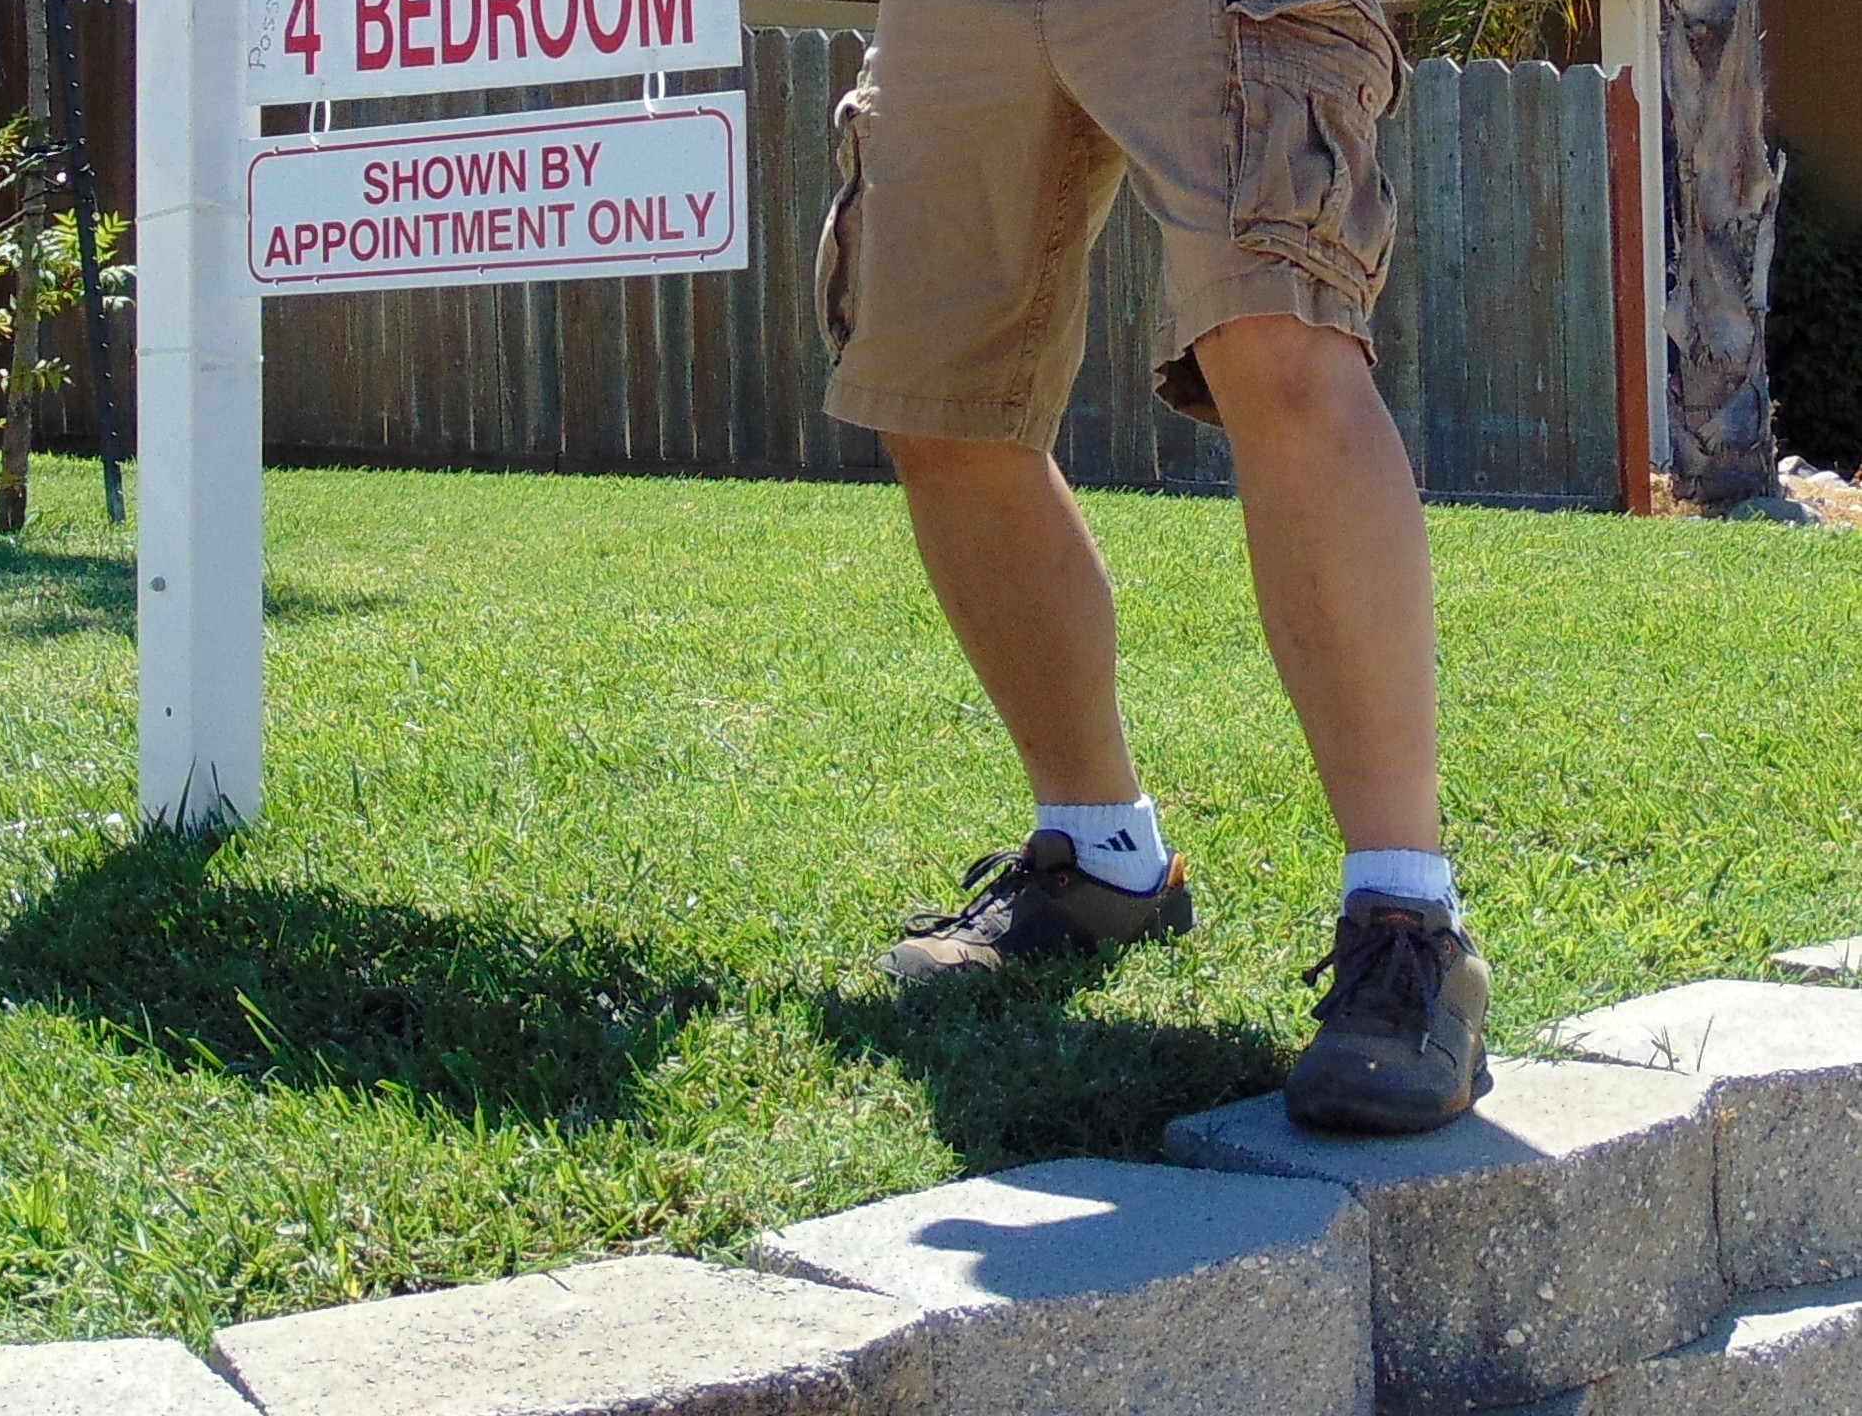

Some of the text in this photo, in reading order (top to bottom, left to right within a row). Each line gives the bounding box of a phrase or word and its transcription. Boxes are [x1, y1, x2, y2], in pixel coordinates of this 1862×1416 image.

[363, 141, 602, 205] SHOWN BY
[264, 191, 717, 267] APPOINTMENT ONLY
